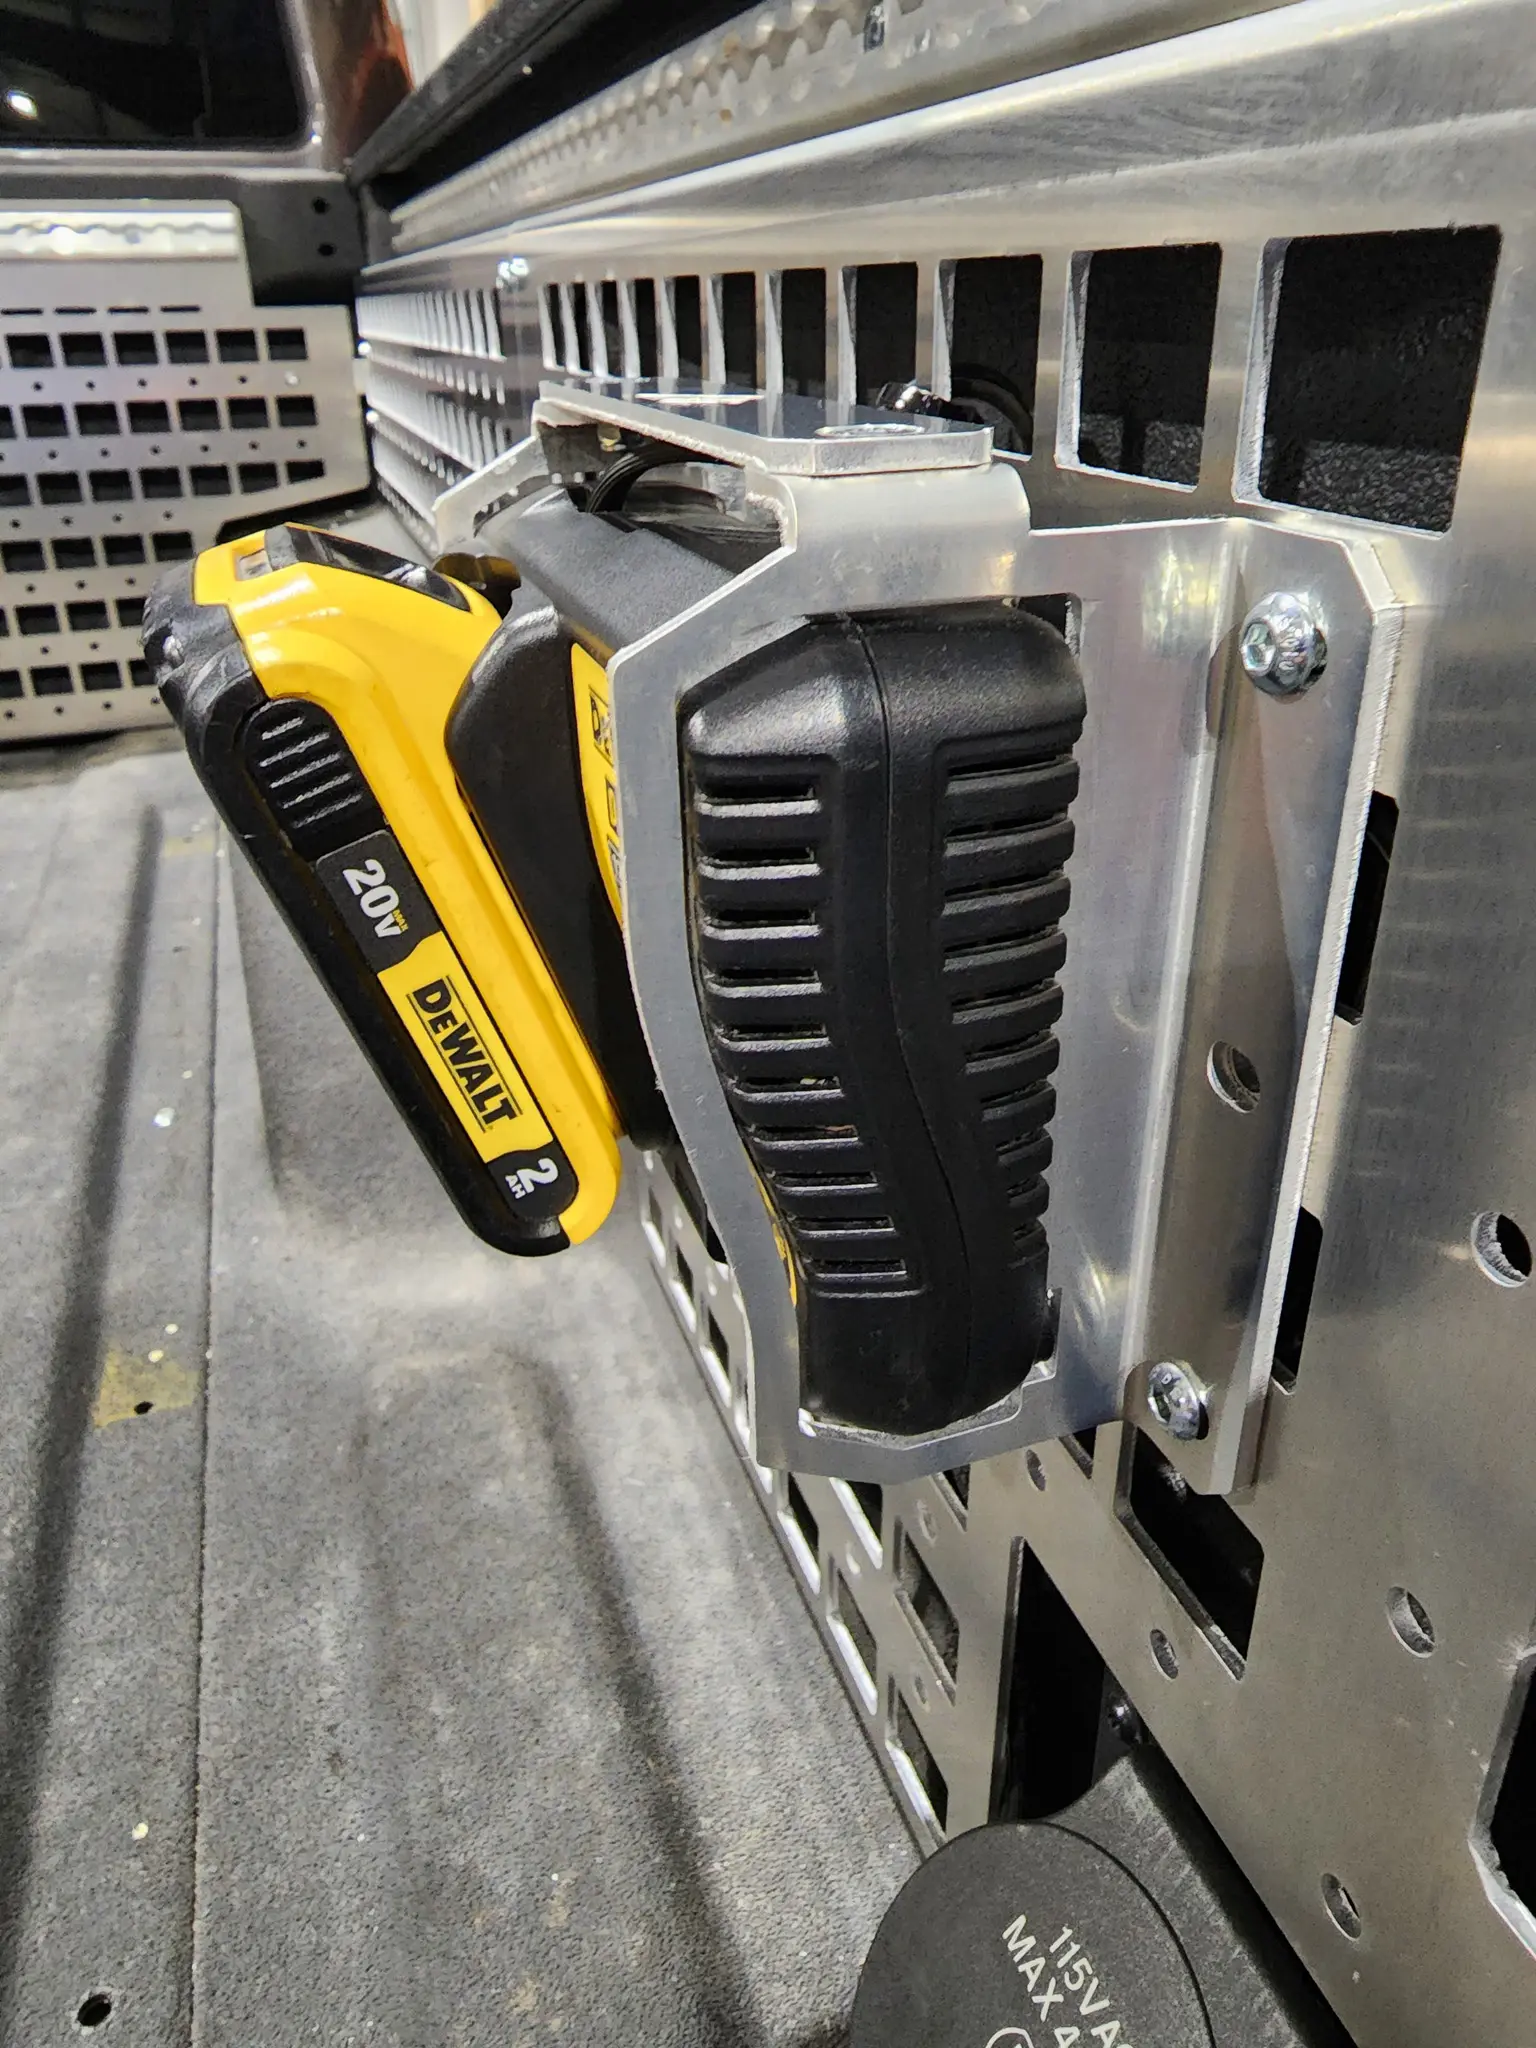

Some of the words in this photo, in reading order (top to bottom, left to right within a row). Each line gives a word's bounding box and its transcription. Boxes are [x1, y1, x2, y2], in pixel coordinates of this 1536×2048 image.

[342, 858, 402, 938] 20V
[516, 1157, 558, 1195] 2
[1002, 1914, 1065, 2022] MAX
